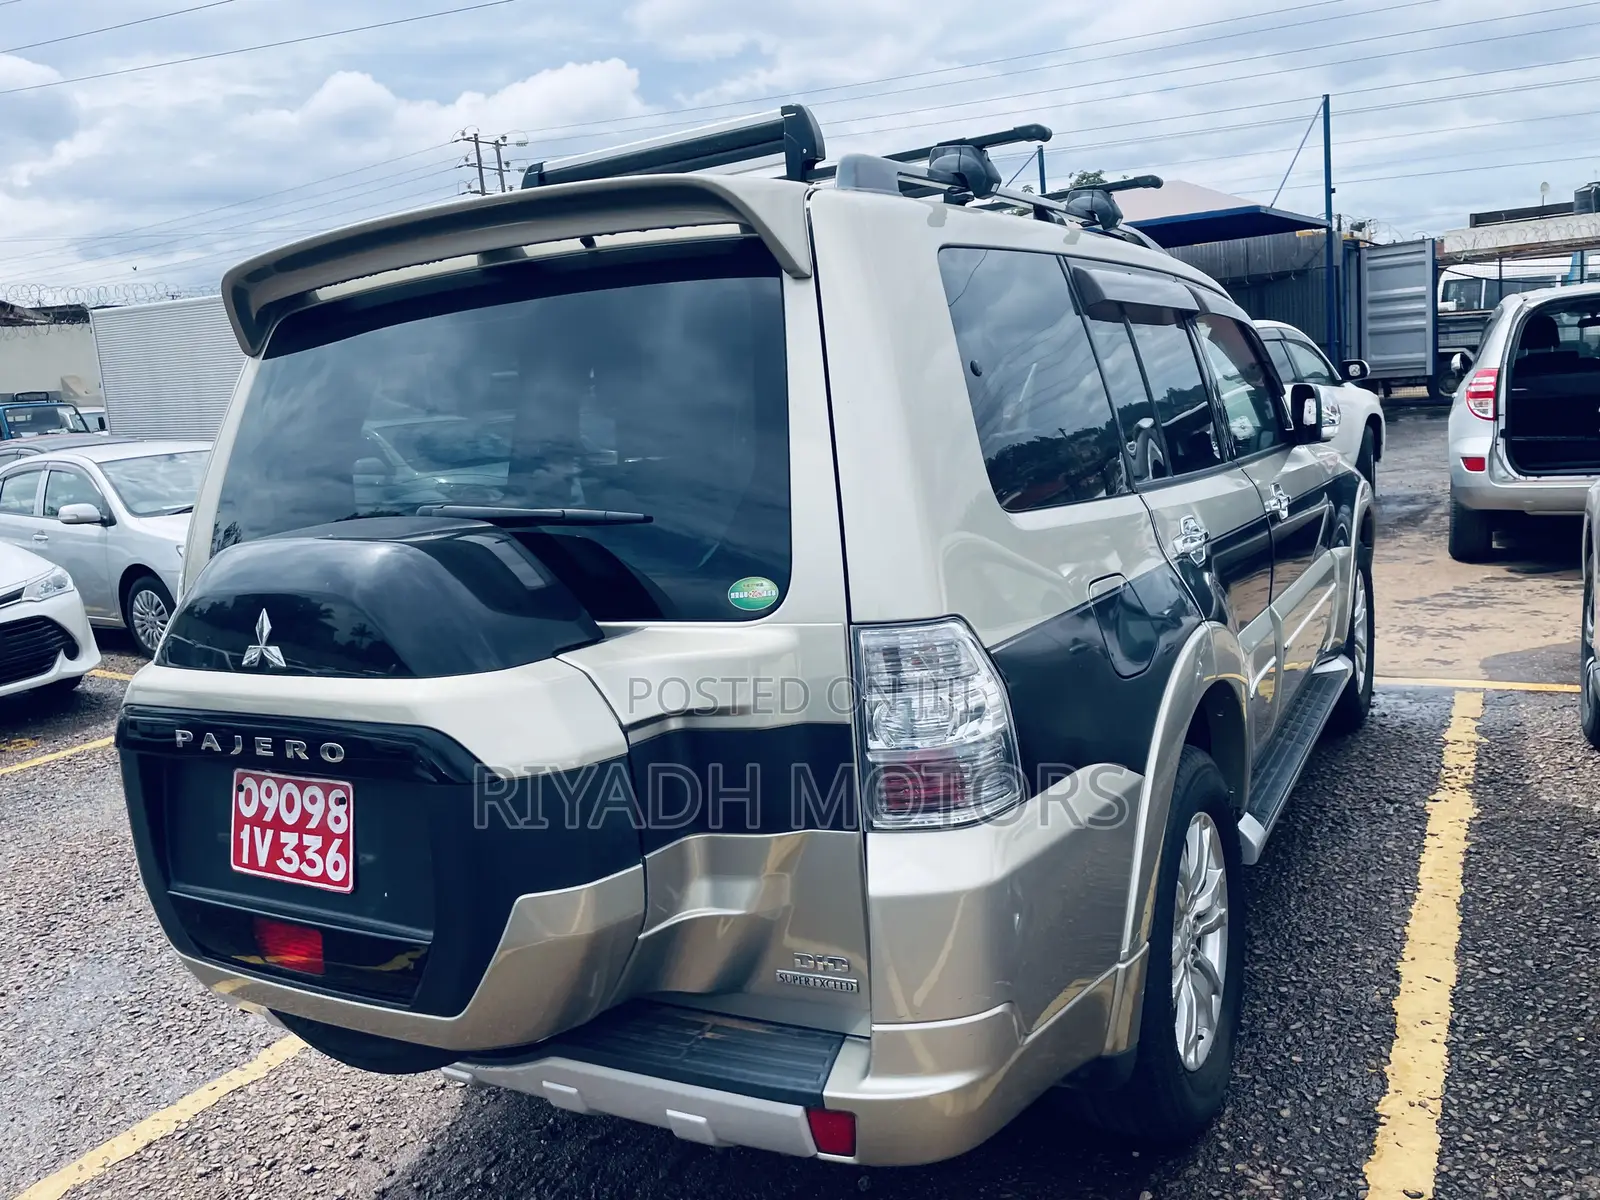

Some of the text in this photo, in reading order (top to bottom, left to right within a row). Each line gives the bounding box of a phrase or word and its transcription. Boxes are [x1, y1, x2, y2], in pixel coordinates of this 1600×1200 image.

[175, 729, 345, 763] PAJERO
[238, 776, 349, 834] 09098
[779, 973, 854, 991] SUPER EXCEED
